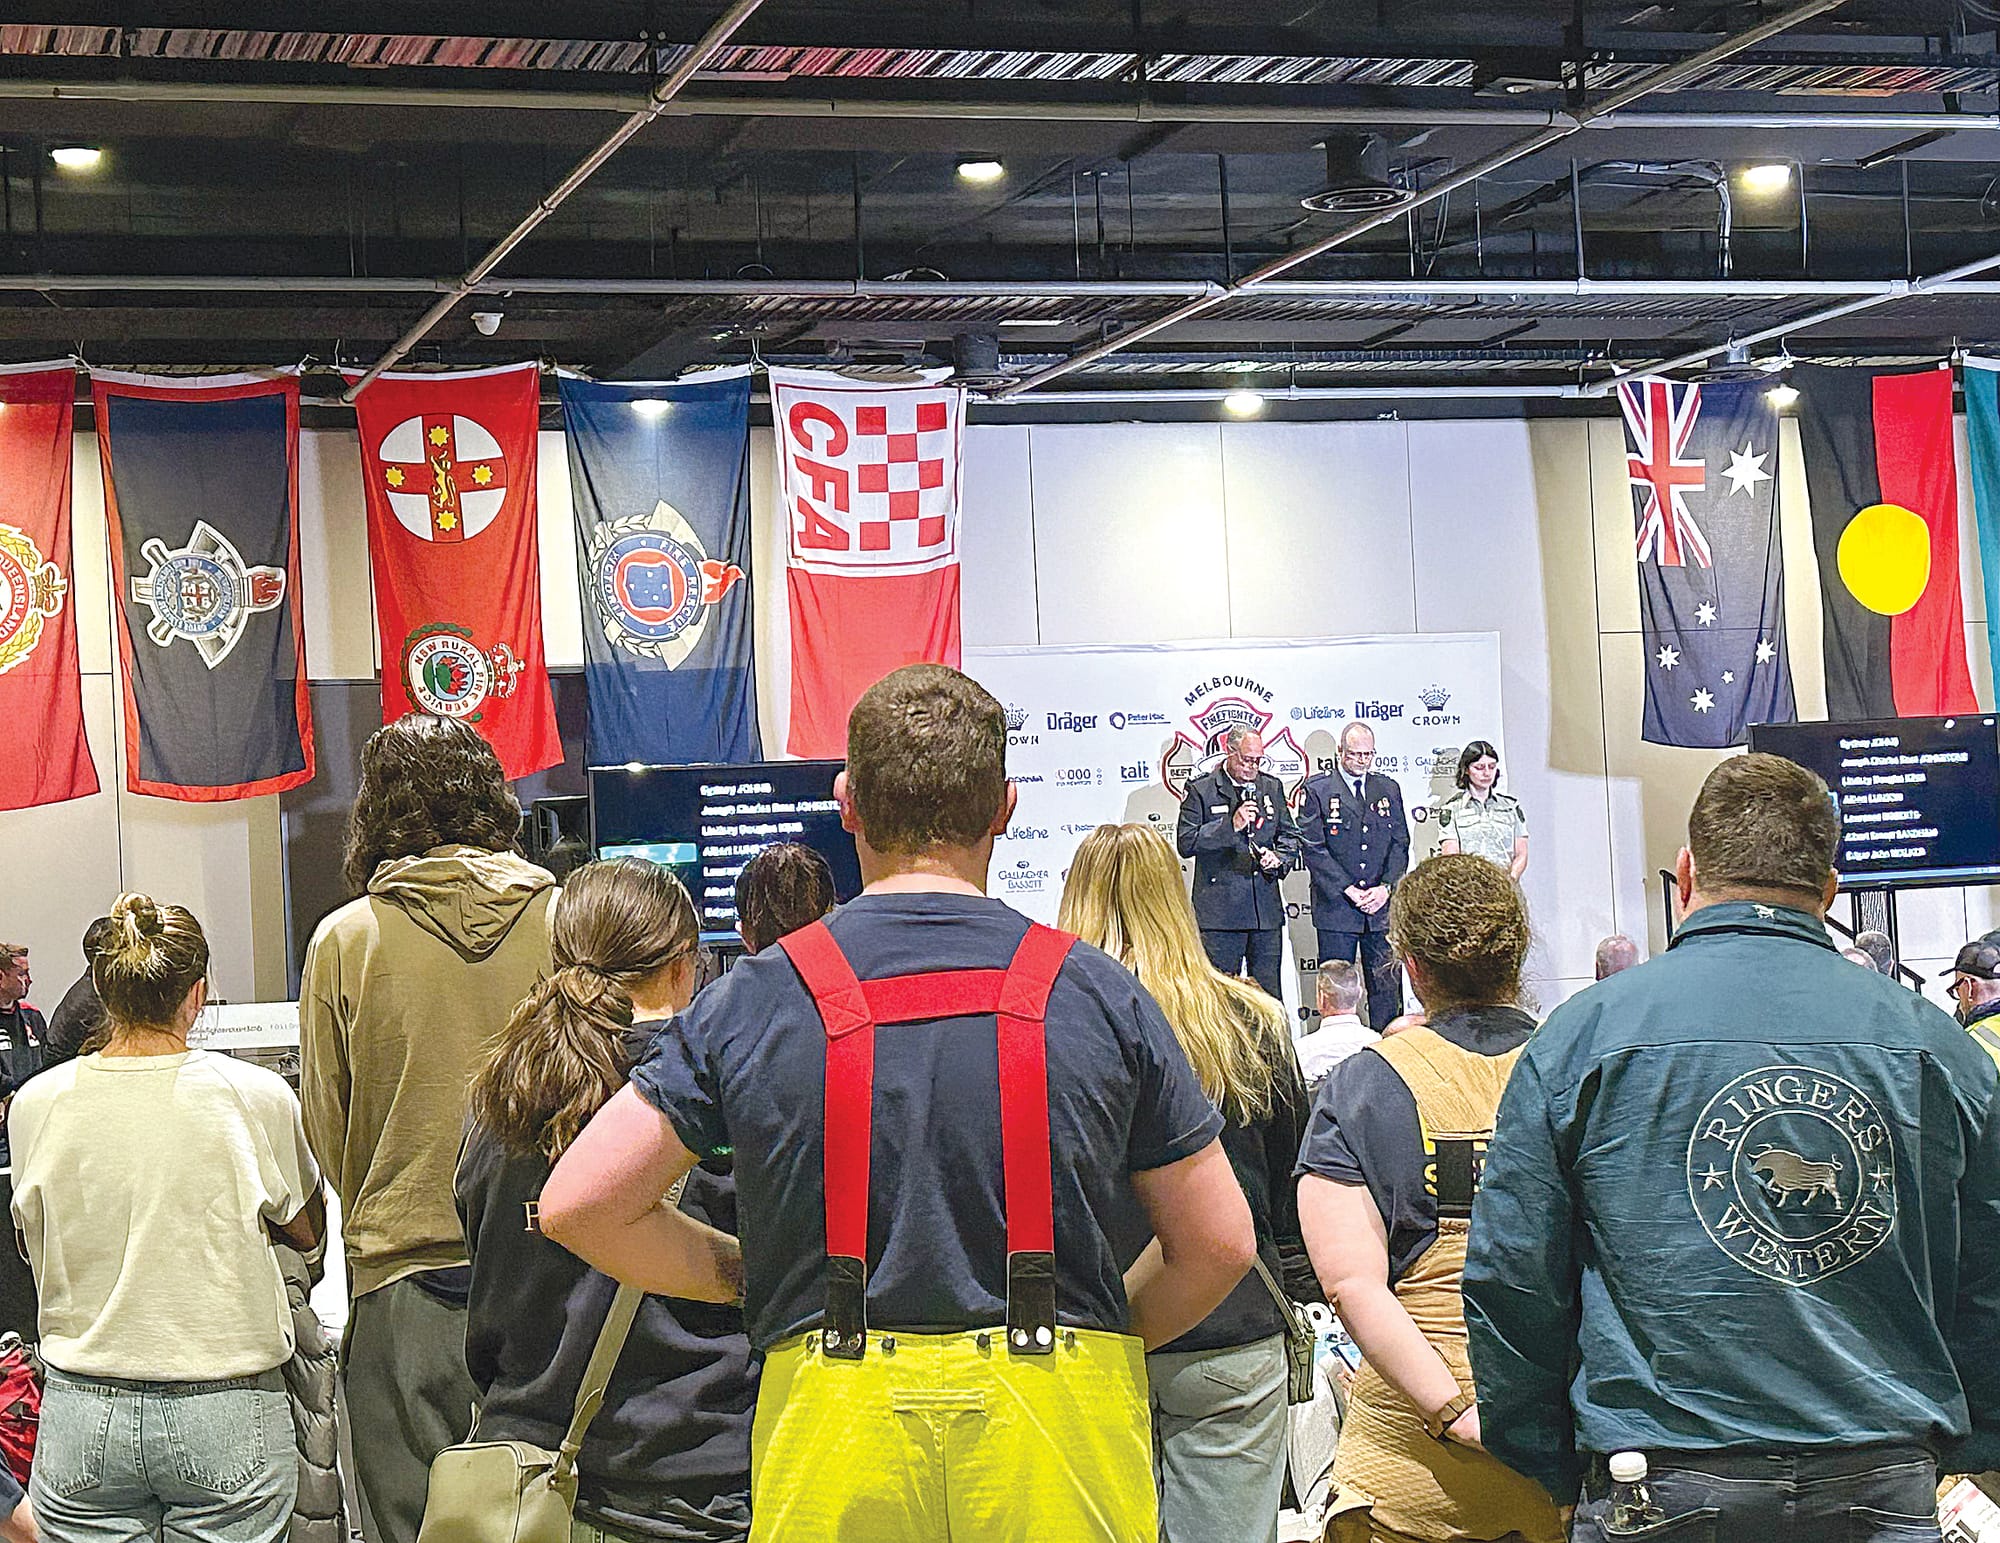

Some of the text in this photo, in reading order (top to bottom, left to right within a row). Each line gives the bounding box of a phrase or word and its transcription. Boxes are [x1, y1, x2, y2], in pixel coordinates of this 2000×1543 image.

[789, 401, 850, 551] CFA
[660, 540, 690, 568] FIRE
[0, 554, 26, 640] UEENSLAND
[415, 641, 437, 665] NSW
[441, 640, 480, 668] RURAL
[1184, 675, 1274, 706] MELBOURNE
[1047, 712, 1098, 733] Dräger
[1355, 700, 1405, 721] Dräger
[1412, 715, 1461, 726] CROWN
[1008, 735, 1039, 746] OWN
[1699, 1075, 1884, 1151] RINGERS
[1715, 1200, 1894, 1279] WESTERN
